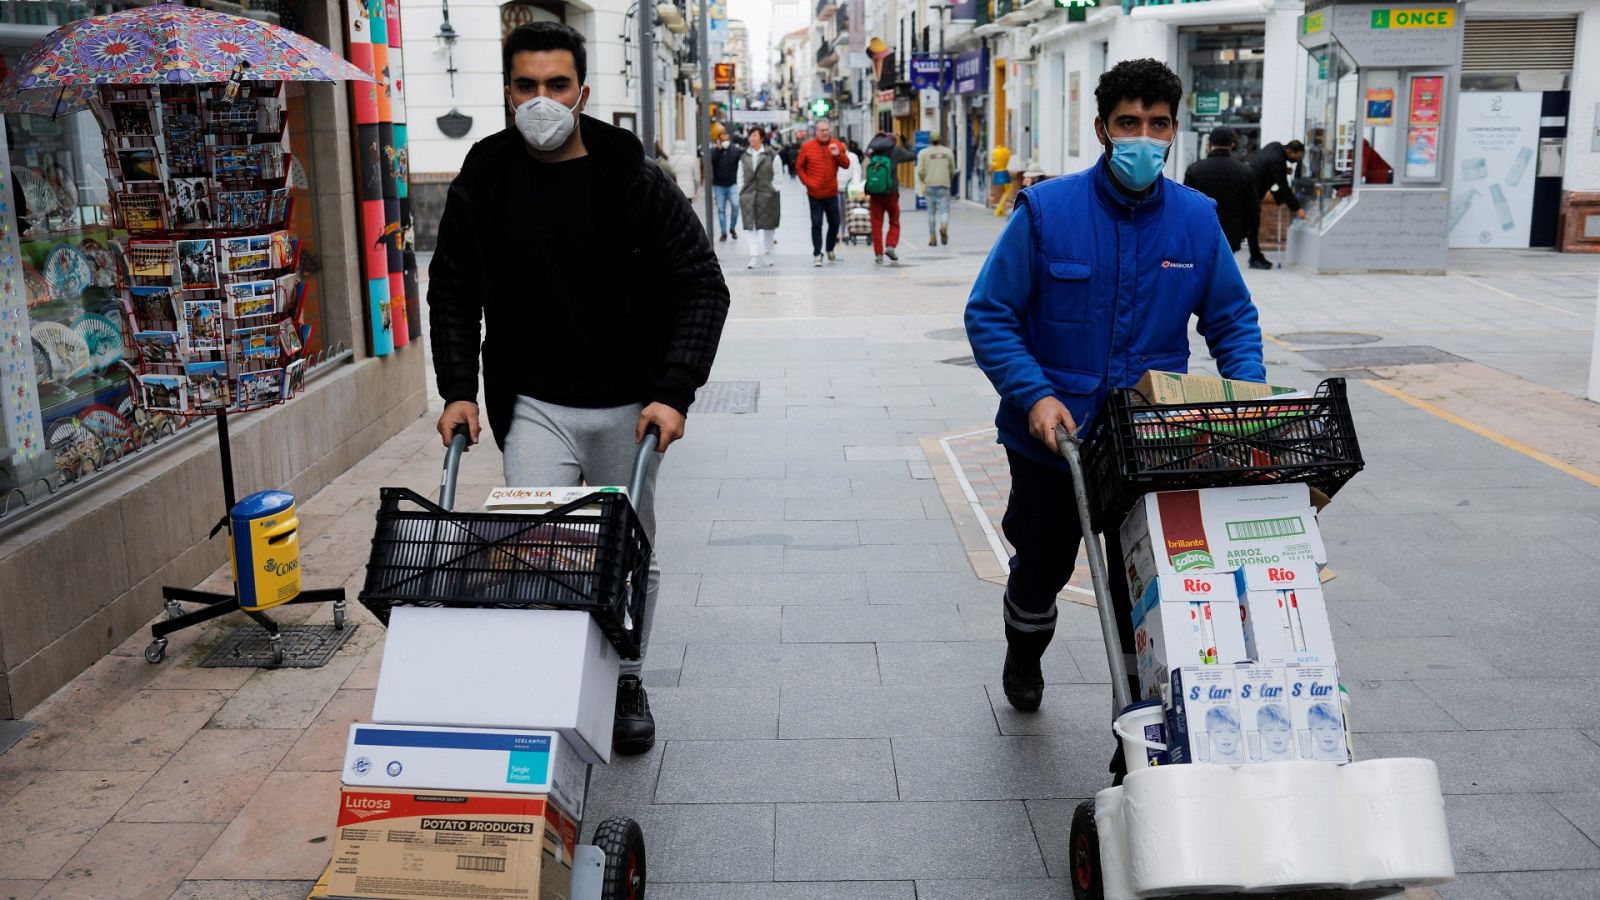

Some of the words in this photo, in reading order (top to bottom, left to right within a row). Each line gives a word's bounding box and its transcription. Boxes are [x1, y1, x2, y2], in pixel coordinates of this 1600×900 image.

[1396, 12, 1448, 25] ONCE
[1168, 539, 1205, 548] brillante
[1227, 548, 1262, 558] ARROZ
[1228, 555, 1280, 567] REDONDO
[511, 765, 530, 775] Single
[510, 773, 531, 781] Frozen
[345, 795, 391, 809] Lutosa
[423, 819, 467, 830] POTATO
[469, 821, 531, 833] PRODUCTS
